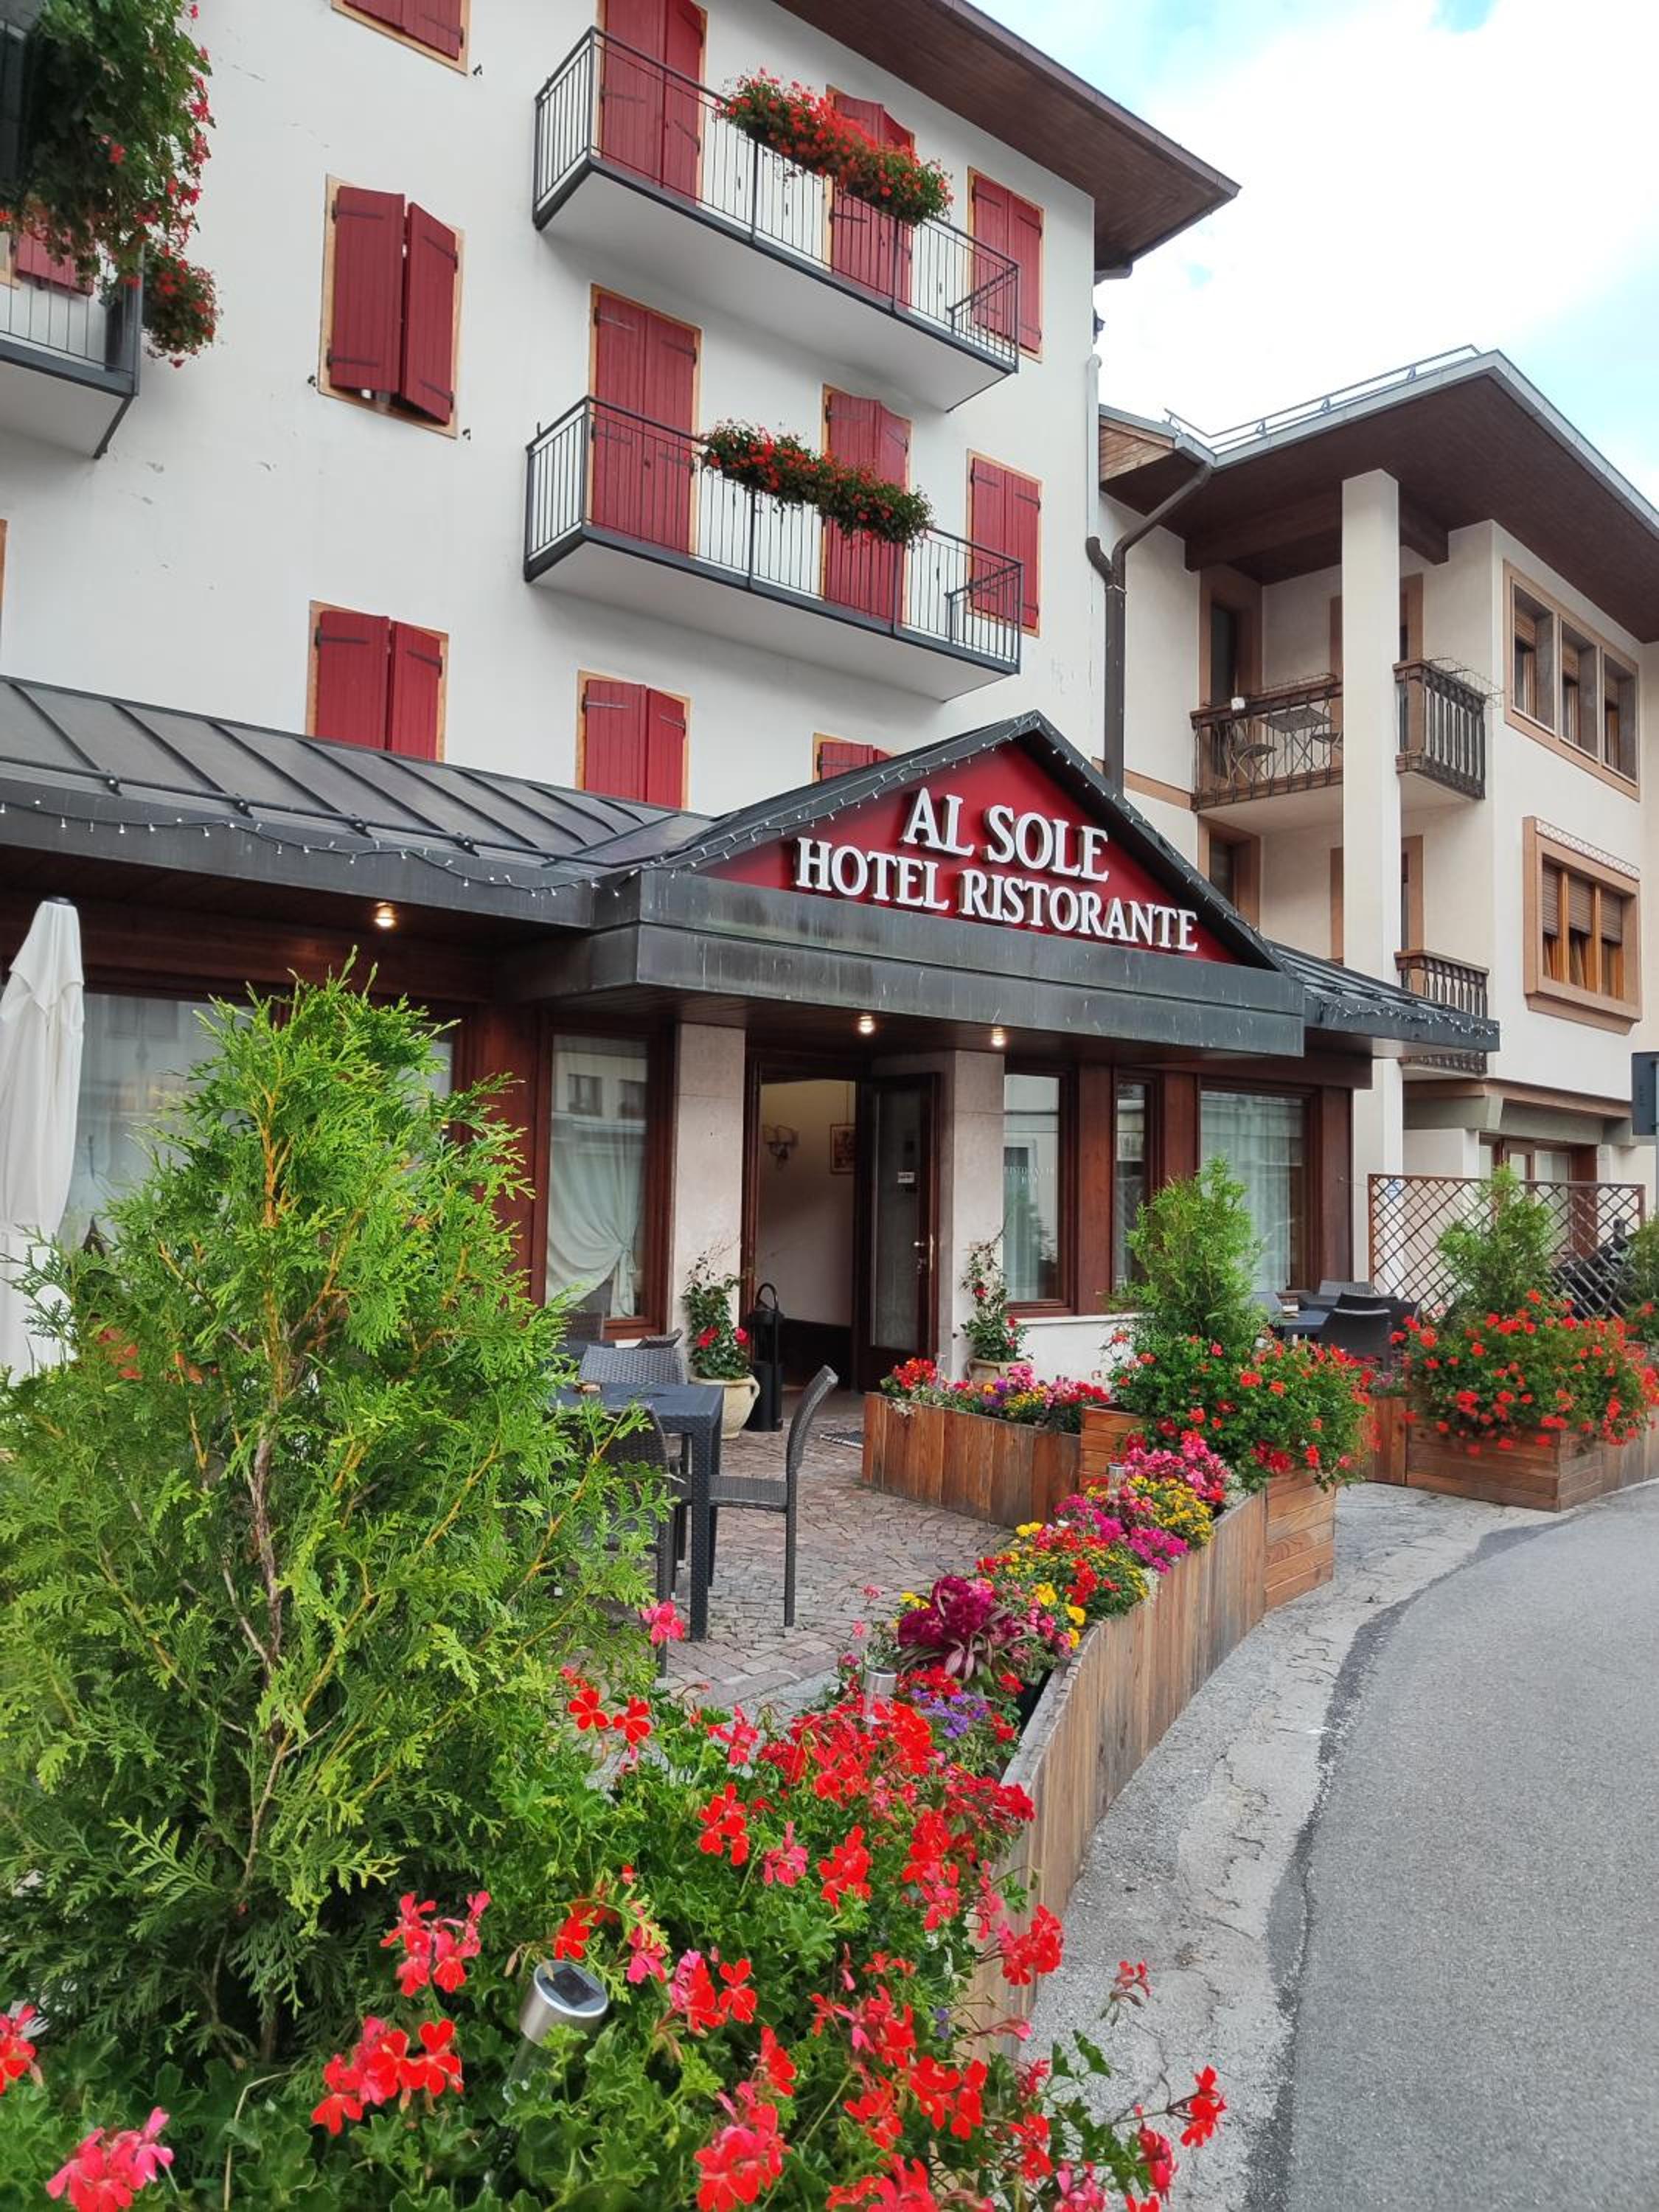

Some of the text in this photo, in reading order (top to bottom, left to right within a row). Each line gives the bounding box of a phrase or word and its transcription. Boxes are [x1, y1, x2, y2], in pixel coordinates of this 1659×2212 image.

[901, 787, 1109, 882] AL SOLE
[796, 837, 1198, 952] HOTEL RISTORANTE
